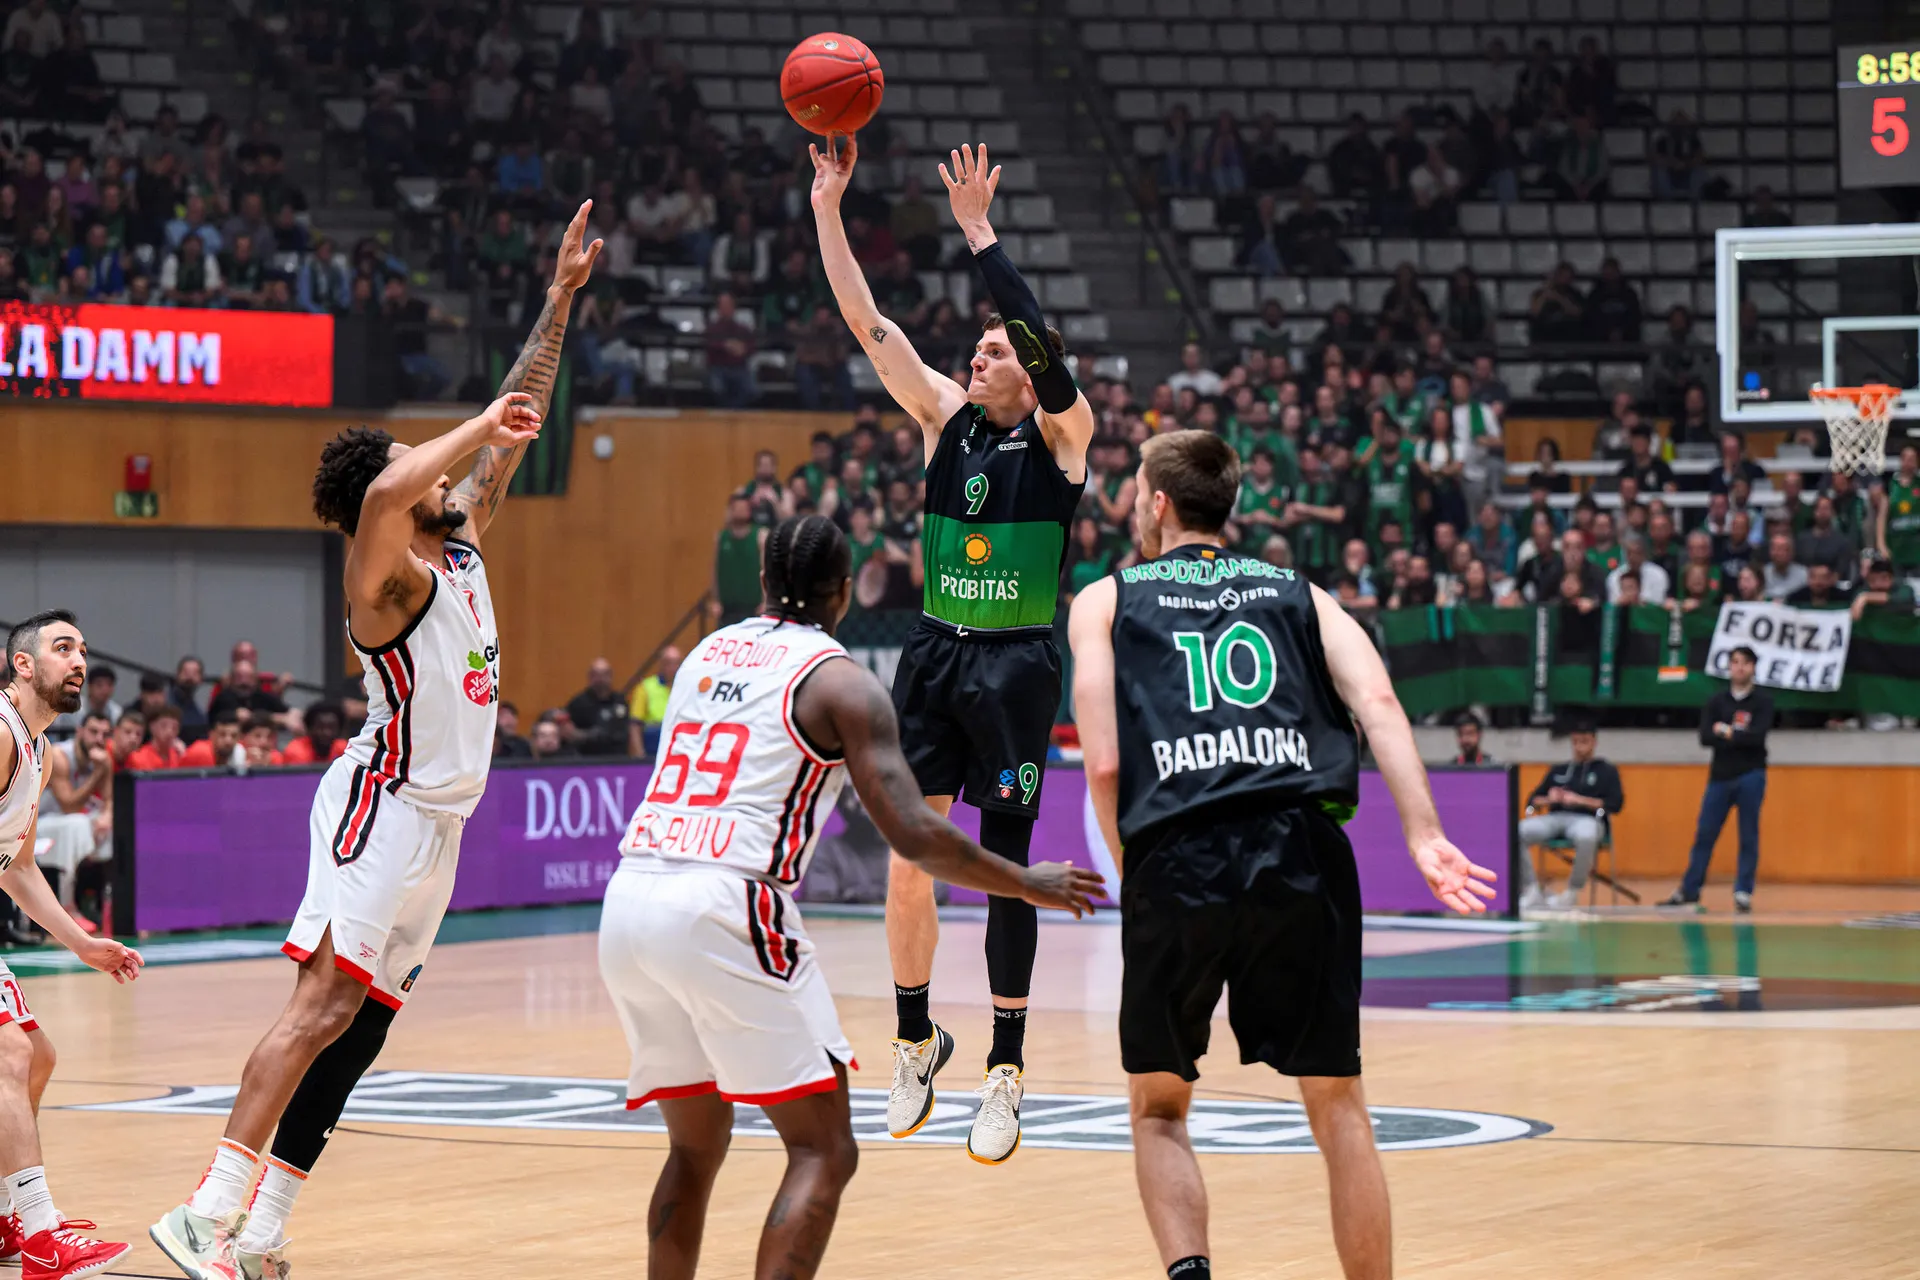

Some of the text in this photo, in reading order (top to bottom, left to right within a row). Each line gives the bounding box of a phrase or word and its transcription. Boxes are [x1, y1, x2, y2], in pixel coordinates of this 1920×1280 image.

[1871, 97, 1910, 156] 5
[61, 325, 221, 385] DAMM
[964, 472, 989, 515] 9
[940, 573, 1020, 600] PROBITAS
[1723, 609, 1844, 651] FORZA
[702, 637, 789, 669] BROWN
[1172, 620, 1278, 713] 10
[711, 680, 751, 702] RK
[647, 722, 750, 807] 69
[1151, 725, 1313, 781] BADALONA
[1018, 762, 1039, 805] 9
